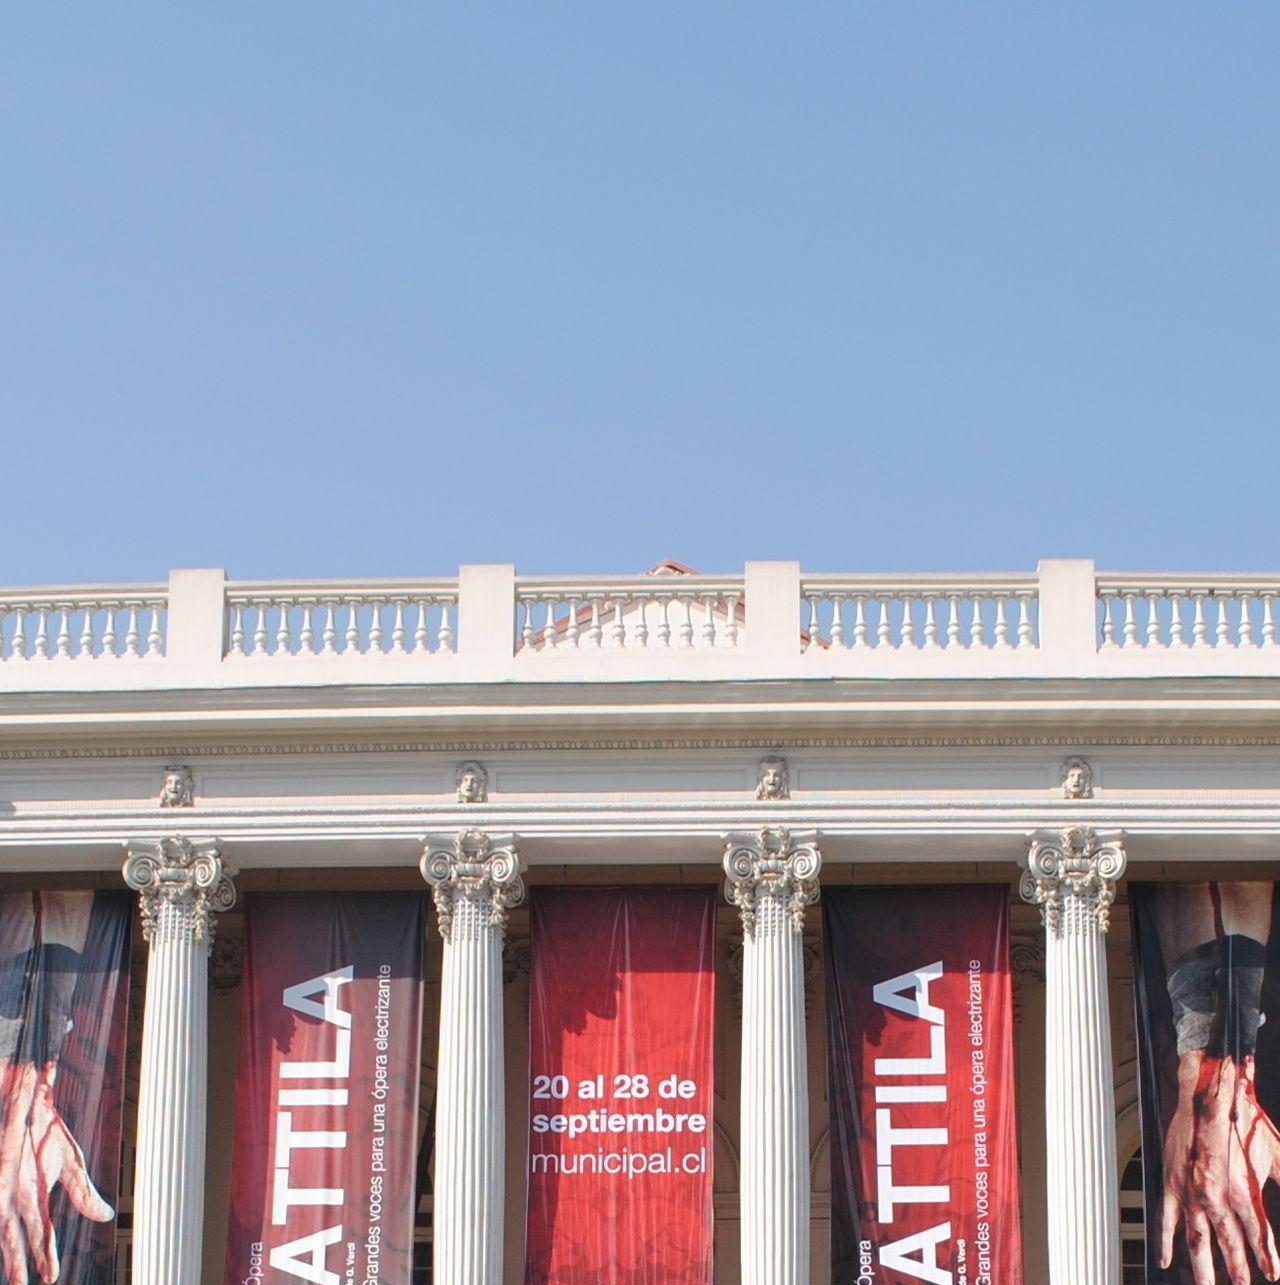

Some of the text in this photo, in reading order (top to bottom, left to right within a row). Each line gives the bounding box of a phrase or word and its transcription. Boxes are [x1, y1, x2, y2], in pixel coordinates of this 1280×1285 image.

[373, 964, 392, 1051] electrizante
[967, 960, 983, 1046] electrizante
[372, 1053, 389, 1100] ópera
[532, 1074, 697, 1099] 20 al 28 de
[969, 1050, 987, 1095] ópera
[373, 1102, 386, 1134] una
[532, 1108, 706, 1139] septiembre
[973, 1099, 986, 1128] una
[371, 1136, 387, 1173] para
[532, 1147, 706, 1180] municipal.cl
[975, 1131, 990, 1168] para
[369, 1175, 383, 1223] voces
[976, 1171, 989, 1219] voces
[346, 1242, 356, 1266] Verdi
[956, 1239, 966, 1263] Verdi
